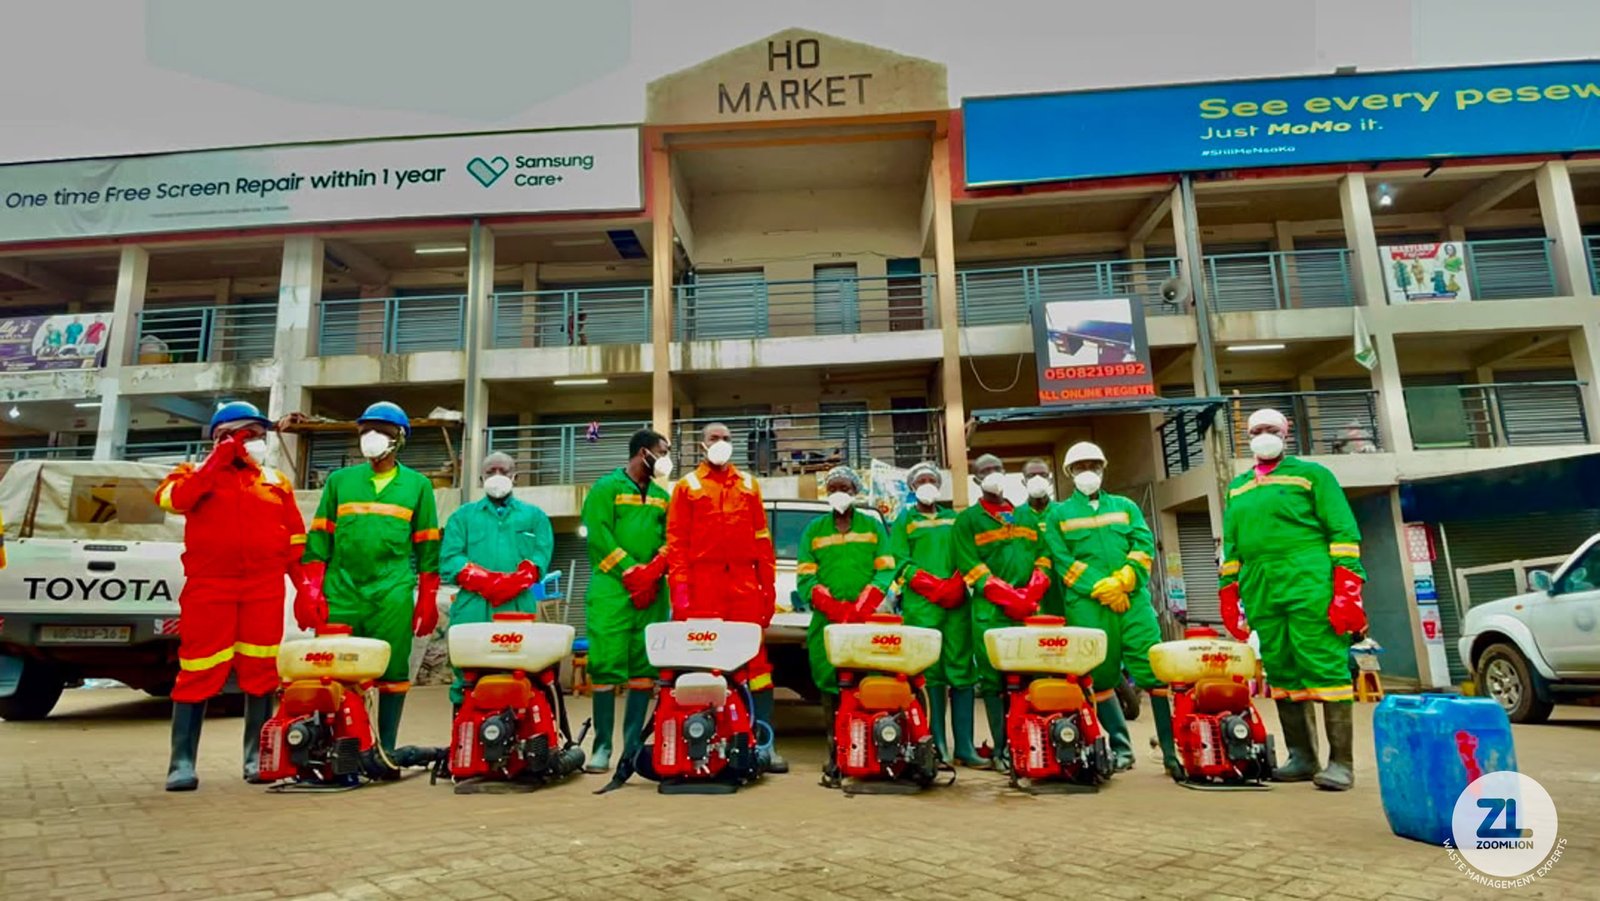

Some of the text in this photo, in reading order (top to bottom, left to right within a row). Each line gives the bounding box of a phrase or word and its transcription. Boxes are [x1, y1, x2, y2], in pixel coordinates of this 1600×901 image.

[768, 38, 820, 72] HO
[718, 73, 873, 114] MARKET
[1200, 98, 1288, 119] See
[1304, 90, 1440, 112] every
[1200, 118, 1384, 140] Just MoMo it.
[515, 153, 595, 171] Samsung
[6, 166, 446, 209] One time Free Screen Repair within 1 year
[514, 173, 564, 188] Care+
[1044, 363, 1146, 380] 0508219992
[1060, 386, 1103, 400] ONLINE
[23, 577, 173, 601] TOYOTA
[490, 632, 524, 644] solo
[687, 631, 718, 642] solo
[871, 634, 902, 646] solo
[1038, 636, 1069, 648] solo
